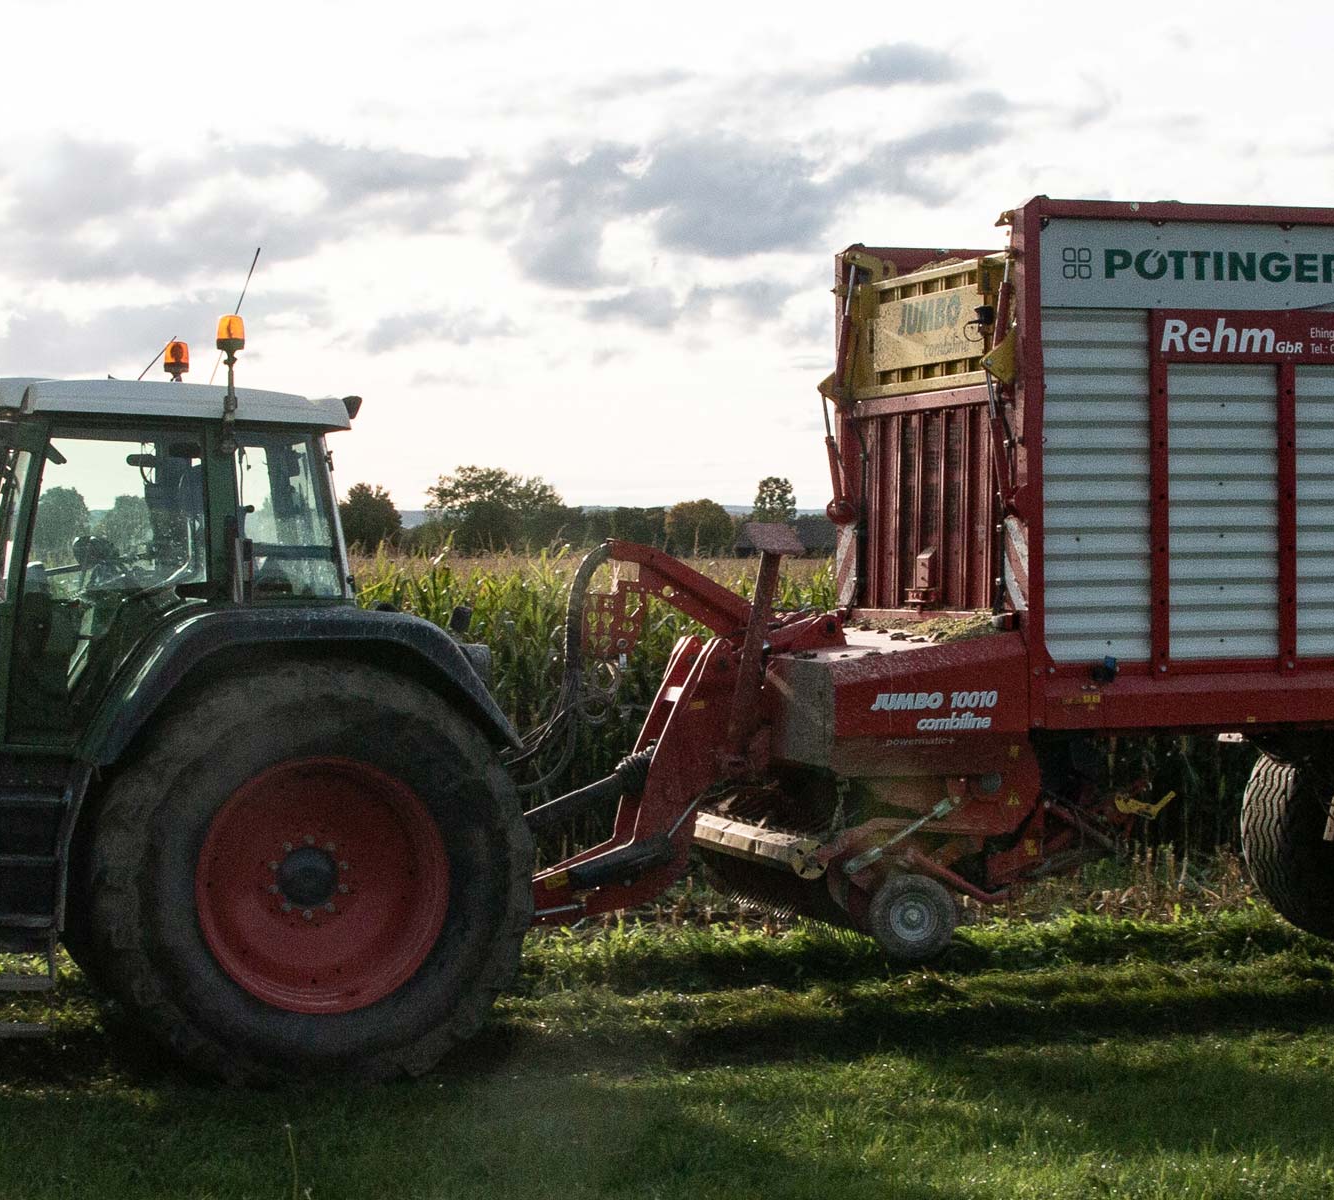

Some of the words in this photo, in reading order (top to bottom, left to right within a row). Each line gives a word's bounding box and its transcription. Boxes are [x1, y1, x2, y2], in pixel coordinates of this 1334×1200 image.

[897, 293, 962, 336] JUMBO
[1160, 318, 1275, 353] Rehm
[1275, 341, 1304, 354] GbR
[1310, 343, 1328, 354] Tel.:
[870, 692, 944, 711] JUMBO
[951, 690, 998, 709] 10010
[916, 711, 992, 731] combiline
